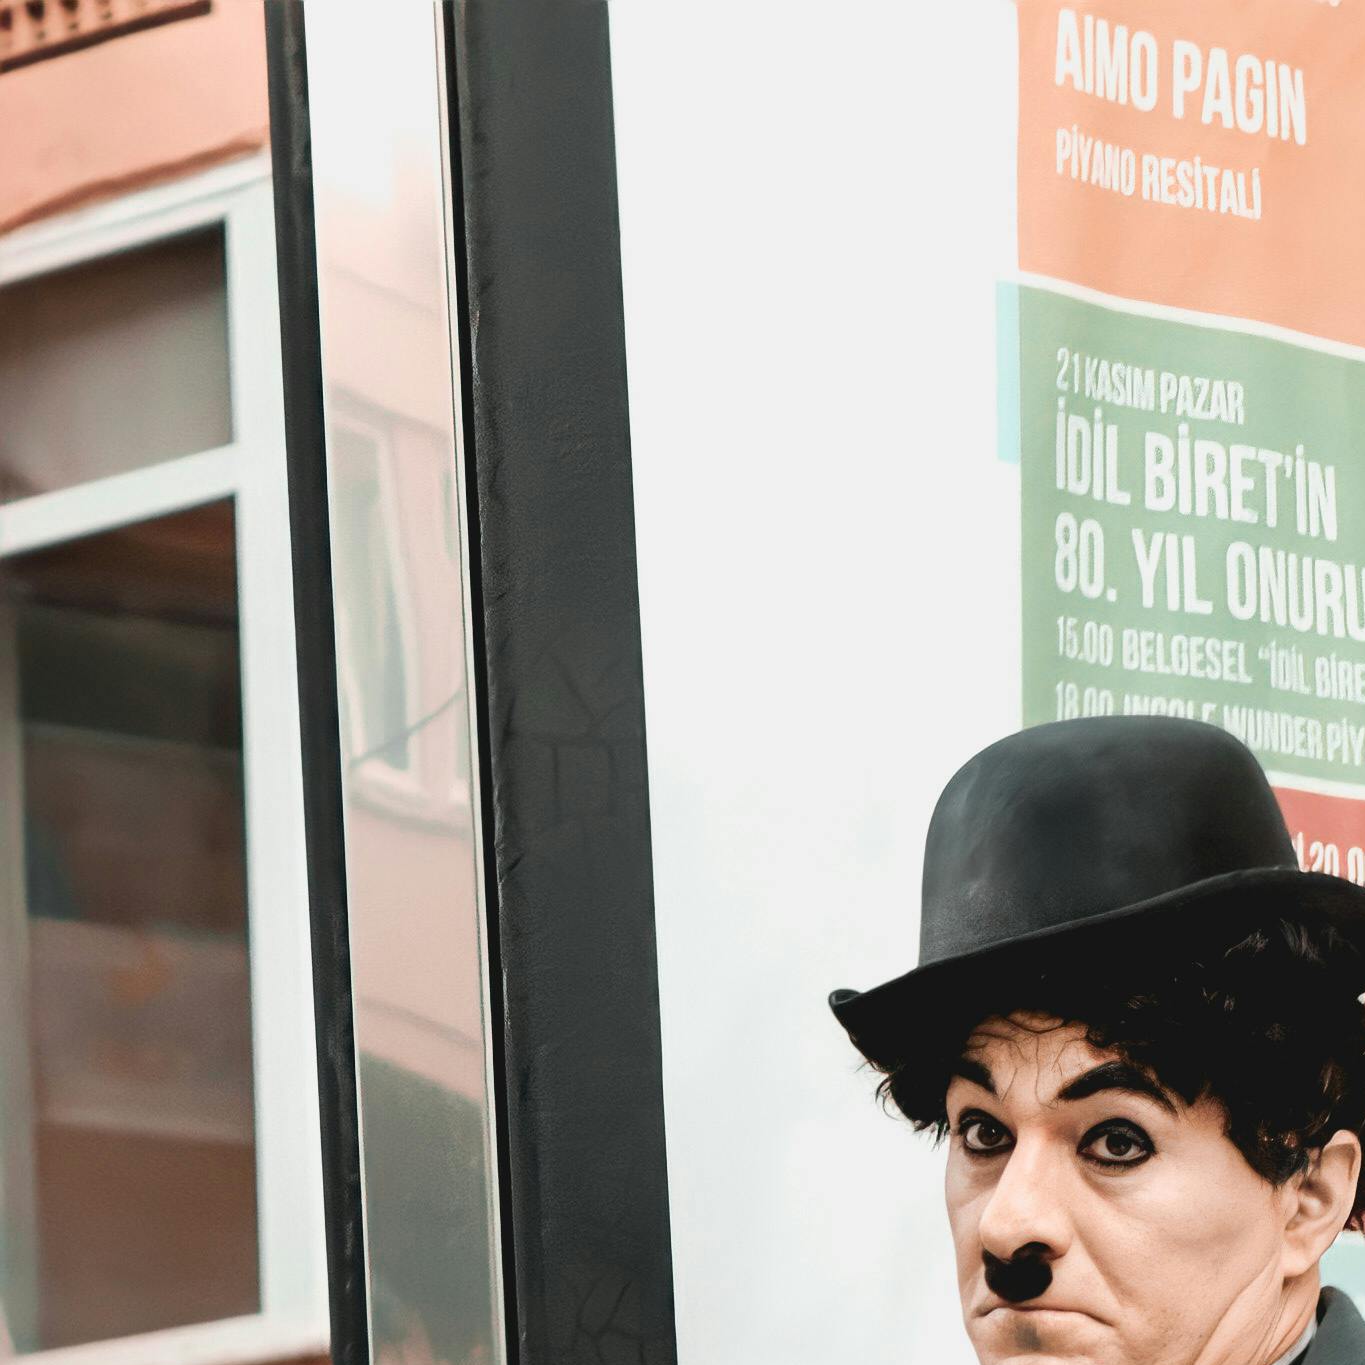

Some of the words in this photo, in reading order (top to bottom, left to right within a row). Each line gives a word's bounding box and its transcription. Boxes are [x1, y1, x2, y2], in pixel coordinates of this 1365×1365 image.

[1055, 8, 1158, 111] AIMO
[1172, 39, 1306, 145] PAGIN
[1055, 124, 1135, 197] PİYANO
[1141, 153, 1261, 219] RESİTALİ
[1056, 348, 1080, 394] 21
[1085, 357, 1155, 412] KASIM
[1160, 368, 1244, 425] PAZAR
[1055, 399, 1130, 506] İDİL
[1055, 512, 1117, 603] 80.
[1131, 528, 1213, 615] YIL
[1056, 616, 1113, 668] 15.00
[1122, 629, 1253, 683] BELGESEL
[1056, 680, 1114, 722] 1800
[1223, 705, 1323, 760] WUNDER
